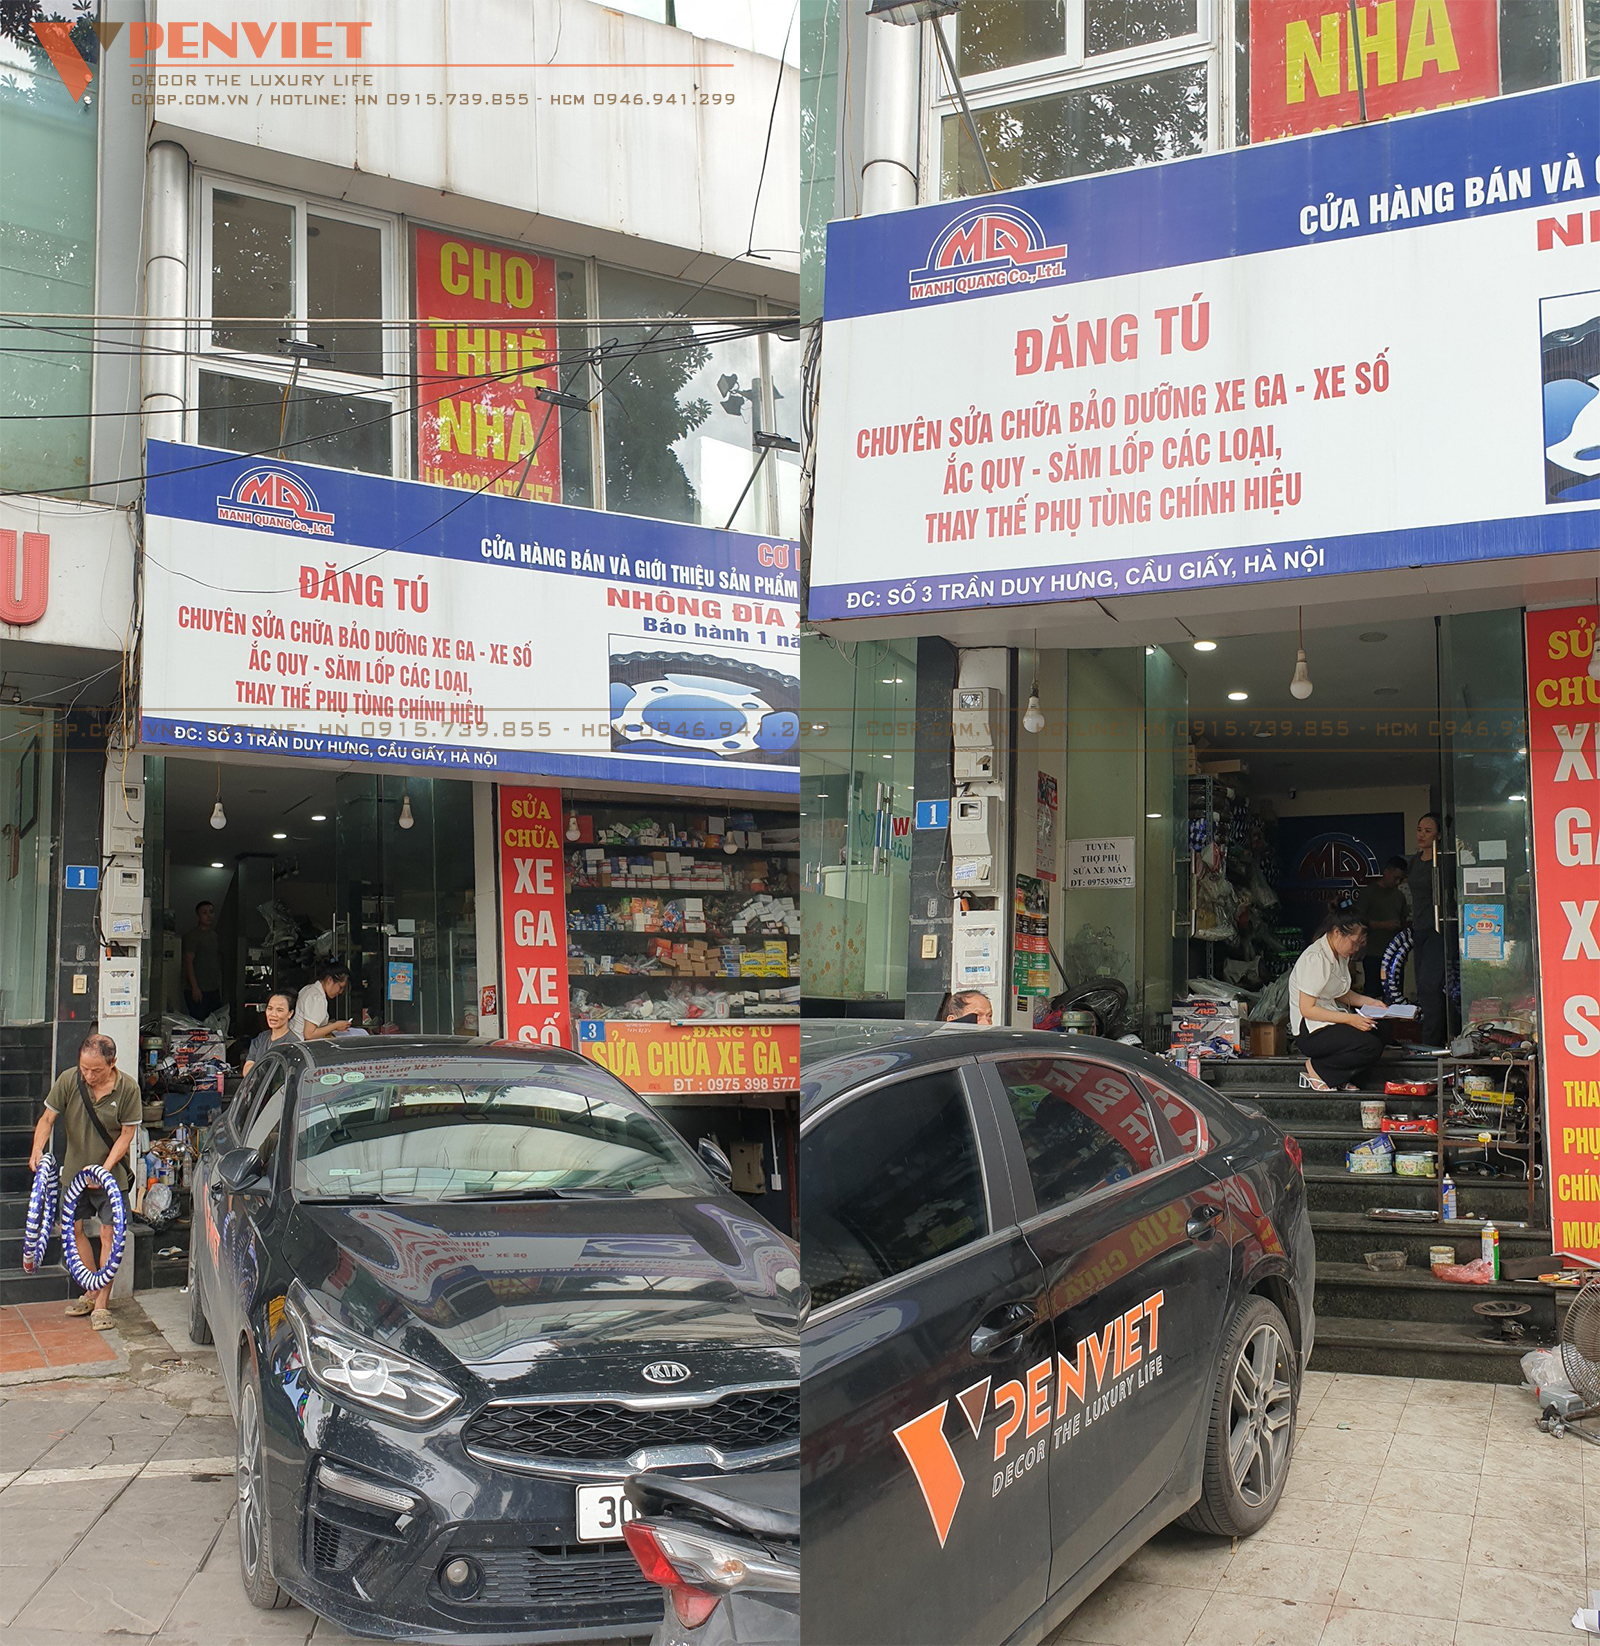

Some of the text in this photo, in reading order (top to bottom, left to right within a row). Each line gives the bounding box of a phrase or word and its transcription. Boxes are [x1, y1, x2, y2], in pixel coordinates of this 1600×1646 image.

[1299, 152, 1585, 236] CỬA HÀNG BÁN VÀ
[440, 241, 534, 309] CHO
[957, 272, 1006, 294] QUANG
[428, 316, 547, 388] THUÊ
[1014, 289, 1210, 377] ĐĂNG TÚ
[856, 347, 1390, 459] CHUYÊN SỬA CHỮA BẢO DƯỠNG XE GA XE SỐ
[438, 396, 539, 467] NHÀ
[943, 424, 1282, 496] ẮC QUY SĂM LỐP CÁC LOẠI,
[254, 514, 292, 529] QUANG
[925, 466, 1302, 544] THAY THẾ PHỤ TÙNG CHÍNH HIỆU
[480, 533, 798, 598] CỬA HÀNG BÁN VÀ GIỚI THIỆU SẢN PHẨM
[757, 543, 789, 568] CƠ
[846, 545, 1325, 609] ĐC: SỐ 3 TRẦN DUY HƯNG, CẦU GIẤY, HÀ NỘI
[299, 561, 429, 613] ĐĂNG TÚ
[606, 586, 786, 628] NHÔNG ĐĨA
[178, 604, 533, 668] CHUYÊN SỬA CHỮA BẢO DƯỠNG XE GA XE SỐ
[643, 616, 766, 646] Bảo hành 1
[249, 640, 473, 697] ẮC QUY SĂM LỐP CÁC LOẠI,
[236, 680, 485, 730] THAY THẾ PHỤ TÙNG CHÍNH HIỆU
[207, 722, 231, 744] SỐ
[233, 731, 243, 745] 3
[247, 727, 289, 749] TRẦN
[292, 735, 324, 752] DUY
[327, 737, 373, 757] HƯNG,
[377, 739, 409, 760] CẦU
[411, 740, 447, 764] GIẤY,
[450, 746, 470, 765] HÀ
[473, 747, 498, 767] NỘI
[511, 792, 552, 821] SỬA
[929, 803, 938, 825] 1
[504, 824, 560, 849] CHỮA
[78, 868, 86, 887] 1
[513, 857, 555, 895] XE
[1093, 866, 1105, 874] XE
[514, 909, 557, 947] GA
[517, 967, 559, 1005] XE
[588, 1024, 597, 1039] 3
[591, 1030, 783, 1076] SỬA CHỮA XE GA
[673, 1078, 694, 1092] ĐT
[707, 1078, 740, 1091] 0975
[744, 1077, 769, 1090] 398
[772, 1077, 796, 1090] 577
[650, 1365, 683, 1378] KIA
[994, 1289, 1164, 1462] PENVIET
[992, 1354, 1164, 1498] DECOR THE LUXURY LIFE
